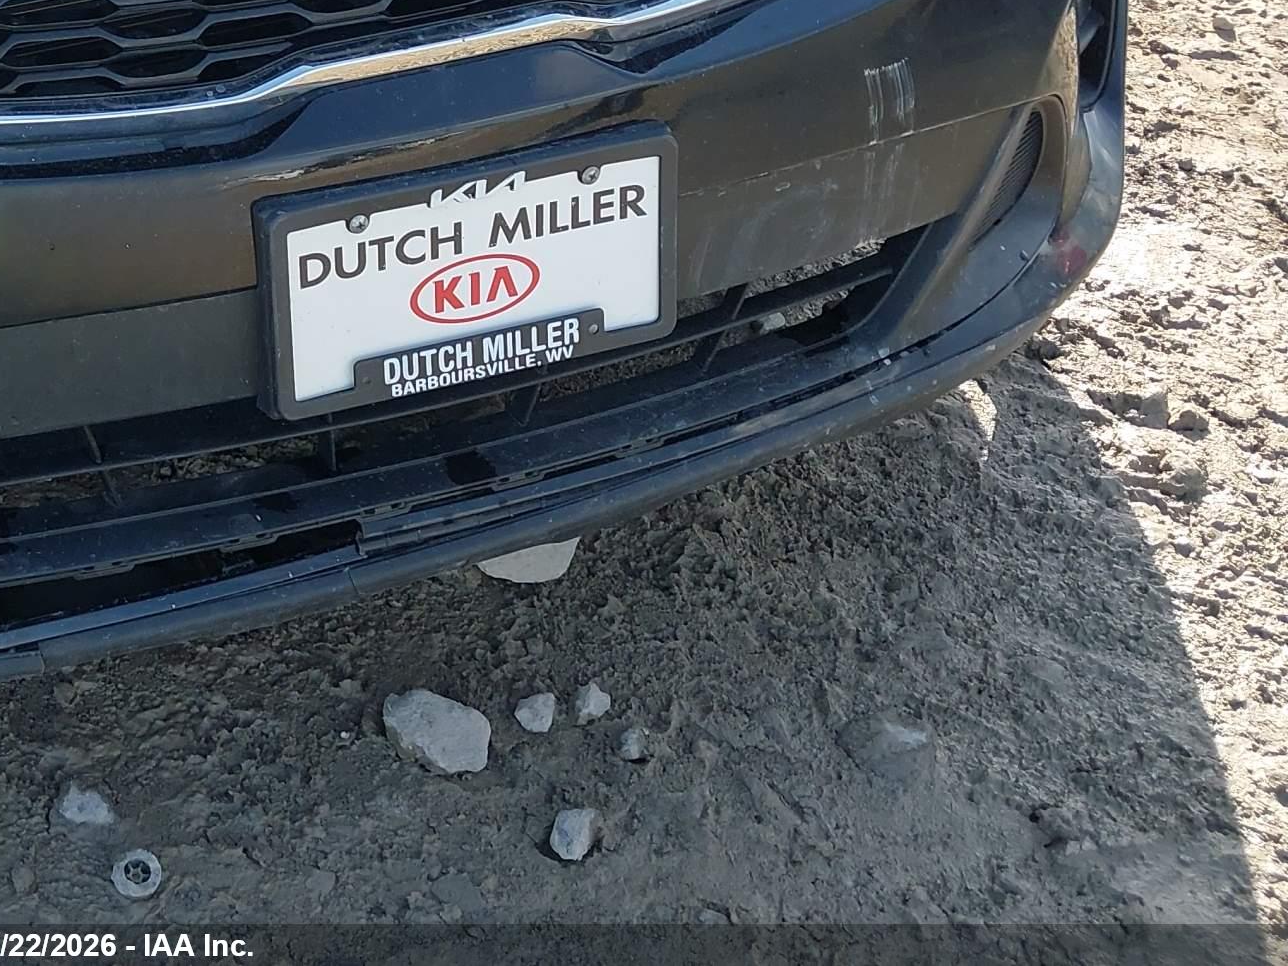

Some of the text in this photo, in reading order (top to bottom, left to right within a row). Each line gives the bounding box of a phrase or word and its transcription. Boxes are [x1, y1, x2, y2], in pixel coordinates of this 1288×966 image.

[299, 185, 647, 290] DUTCH MILLER
[434, 269, 518, 314] KIA
[383, 318, 580, 384] DUTCH MILLER
[545, 345, 574, 364] WV
